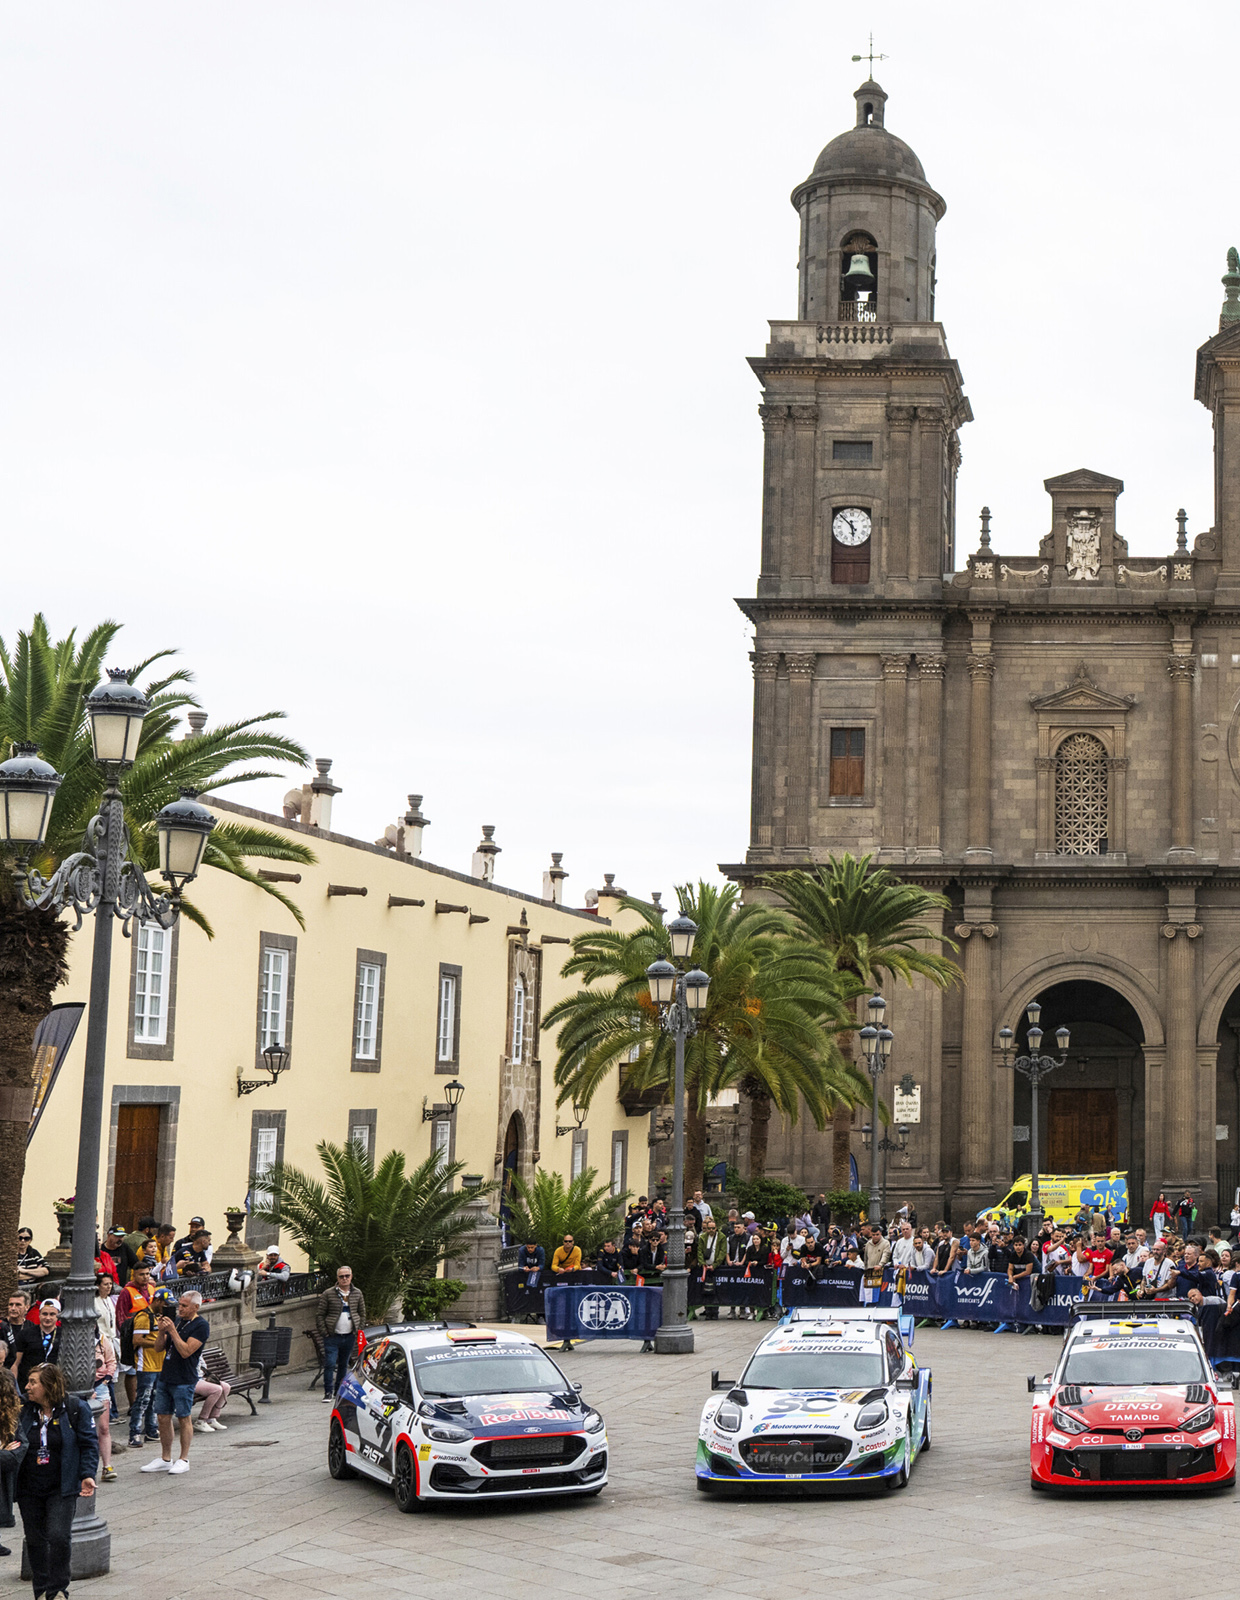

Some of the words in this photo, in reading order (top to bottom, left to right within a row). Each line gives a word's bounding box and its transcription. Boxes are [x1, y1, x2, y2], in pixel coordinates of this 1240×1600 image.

[887, 1282, 929, 1294] HKOOK
[425, 1348, 533, 1361] WRC-FANSHOP.COM
[1104, 1403, 1163, 1411] DENSO
[479, 1410, 524, 1426] Red
[525, 1409, 571, 1421] Bull
[1109, 1414, 1160, 1422] TAMADIC
[1163, 1435, 1185, 1443] CCI
[713, 1443, 732, 1454] Castrol
[865, 1440, 887, 1452] Castrol
